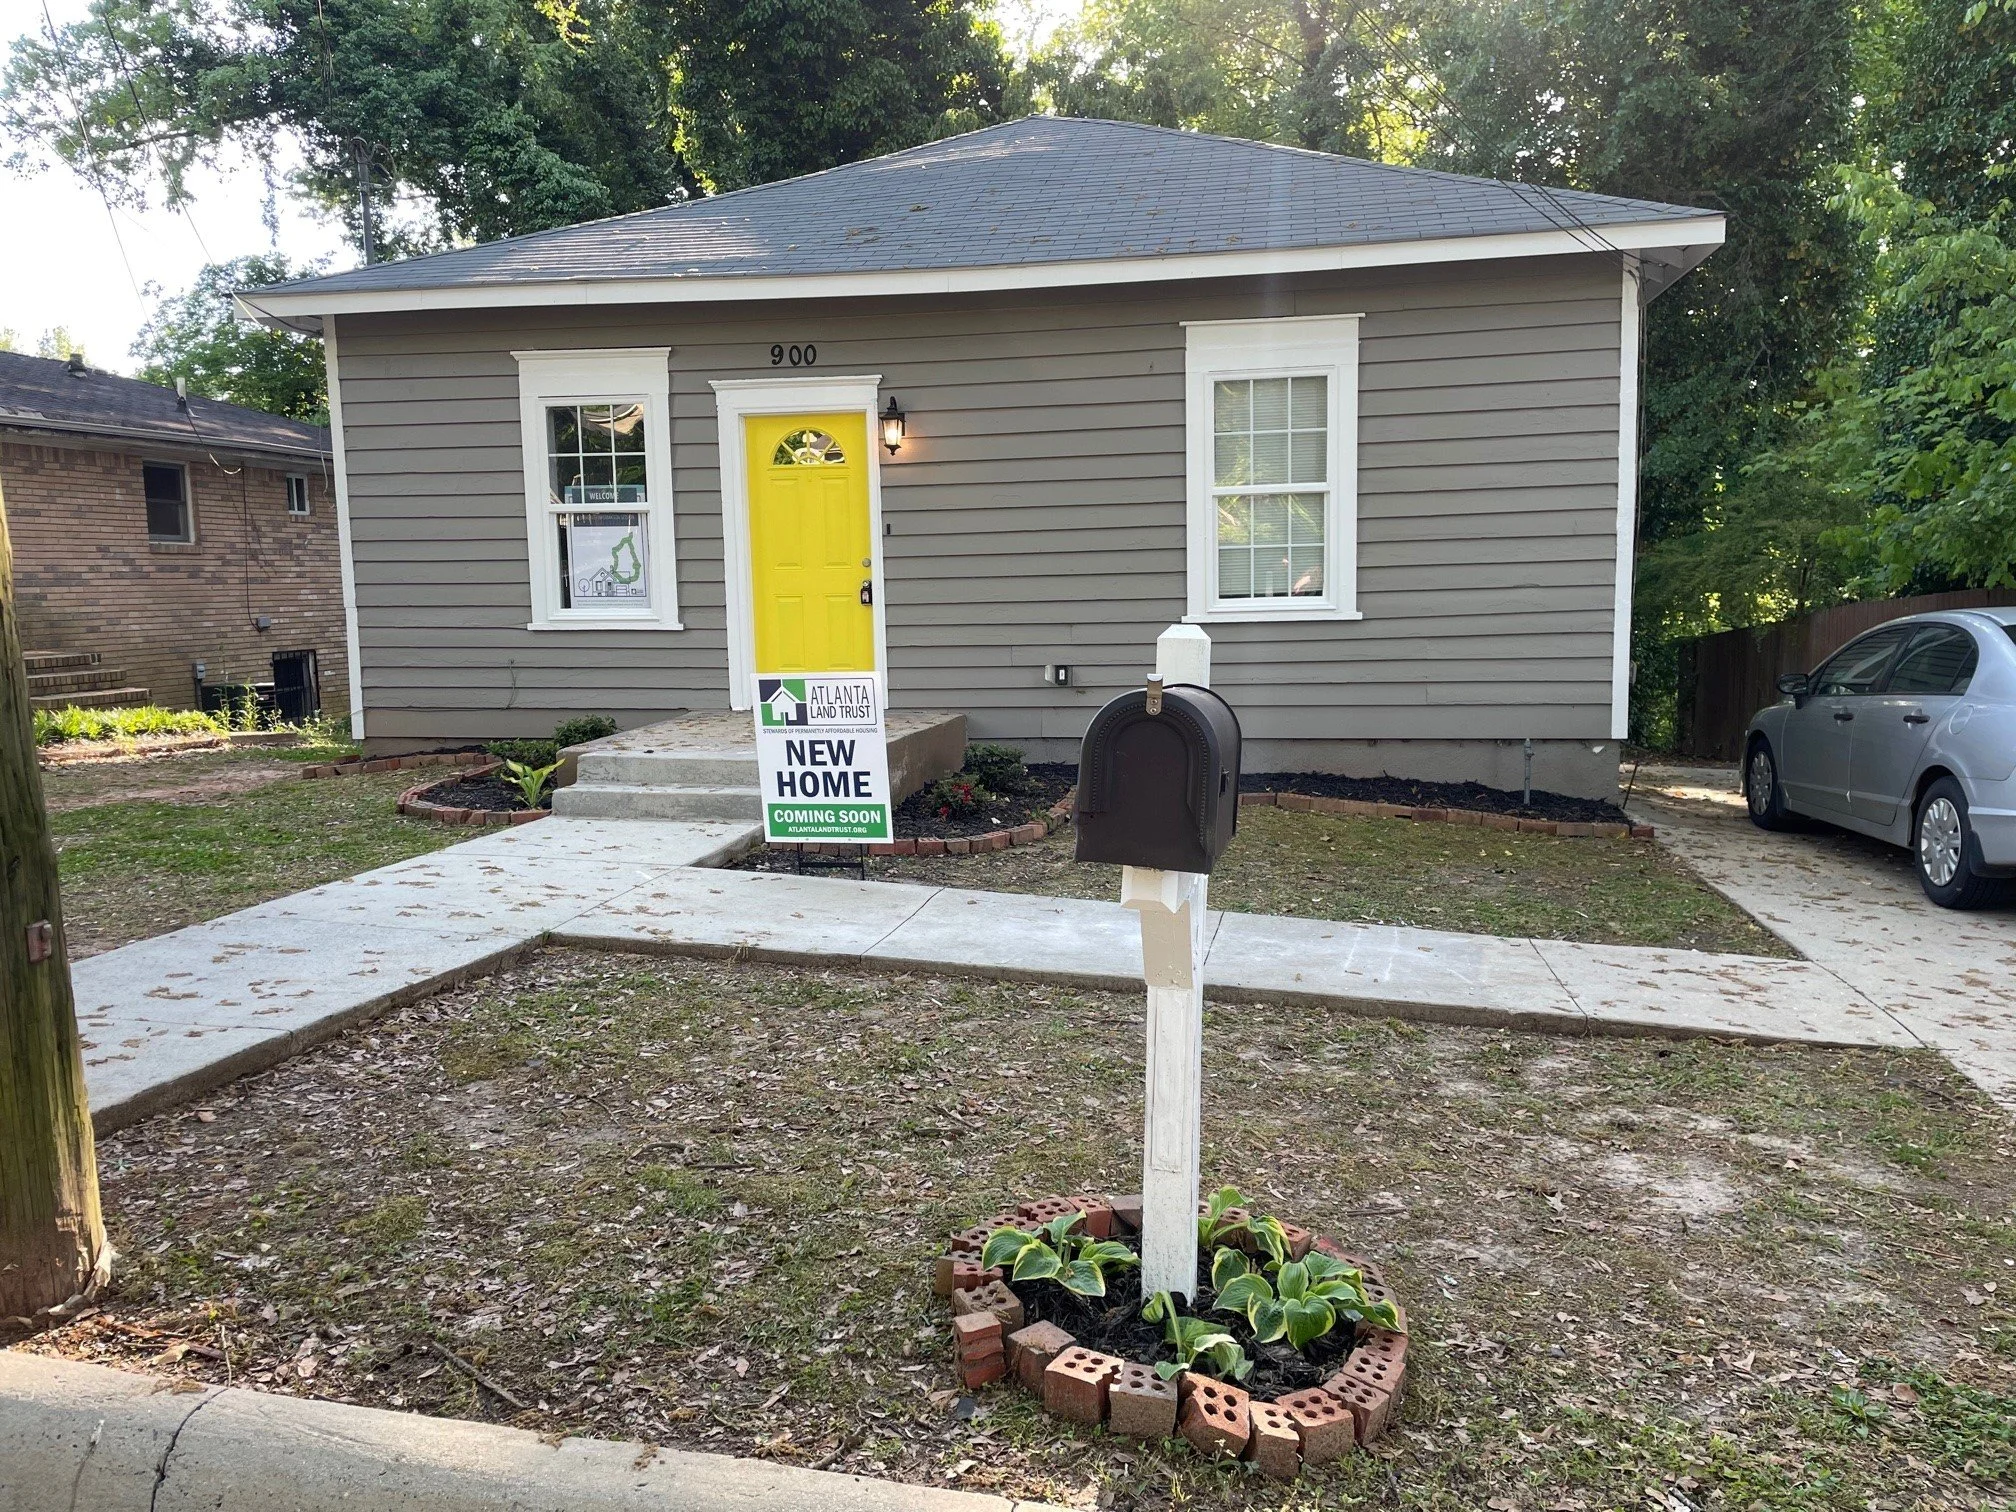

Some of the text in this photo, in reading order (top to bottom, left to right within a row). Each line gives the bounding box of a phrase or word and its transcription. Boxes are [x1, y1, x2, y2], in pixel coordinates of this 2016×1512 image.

[770, 344, 817, 366] 900
[810, 685, 870, 705] ATLANTA
[810, 705, 871, 719] LAND TRUST
[785, 739, 856, 766] NEW
[776, 771, 873, 798] HOME
[773, 809, 881, 824] COMING SOON
[787, 826, 868, 834] ATLANTALANDTRUST.ORG
